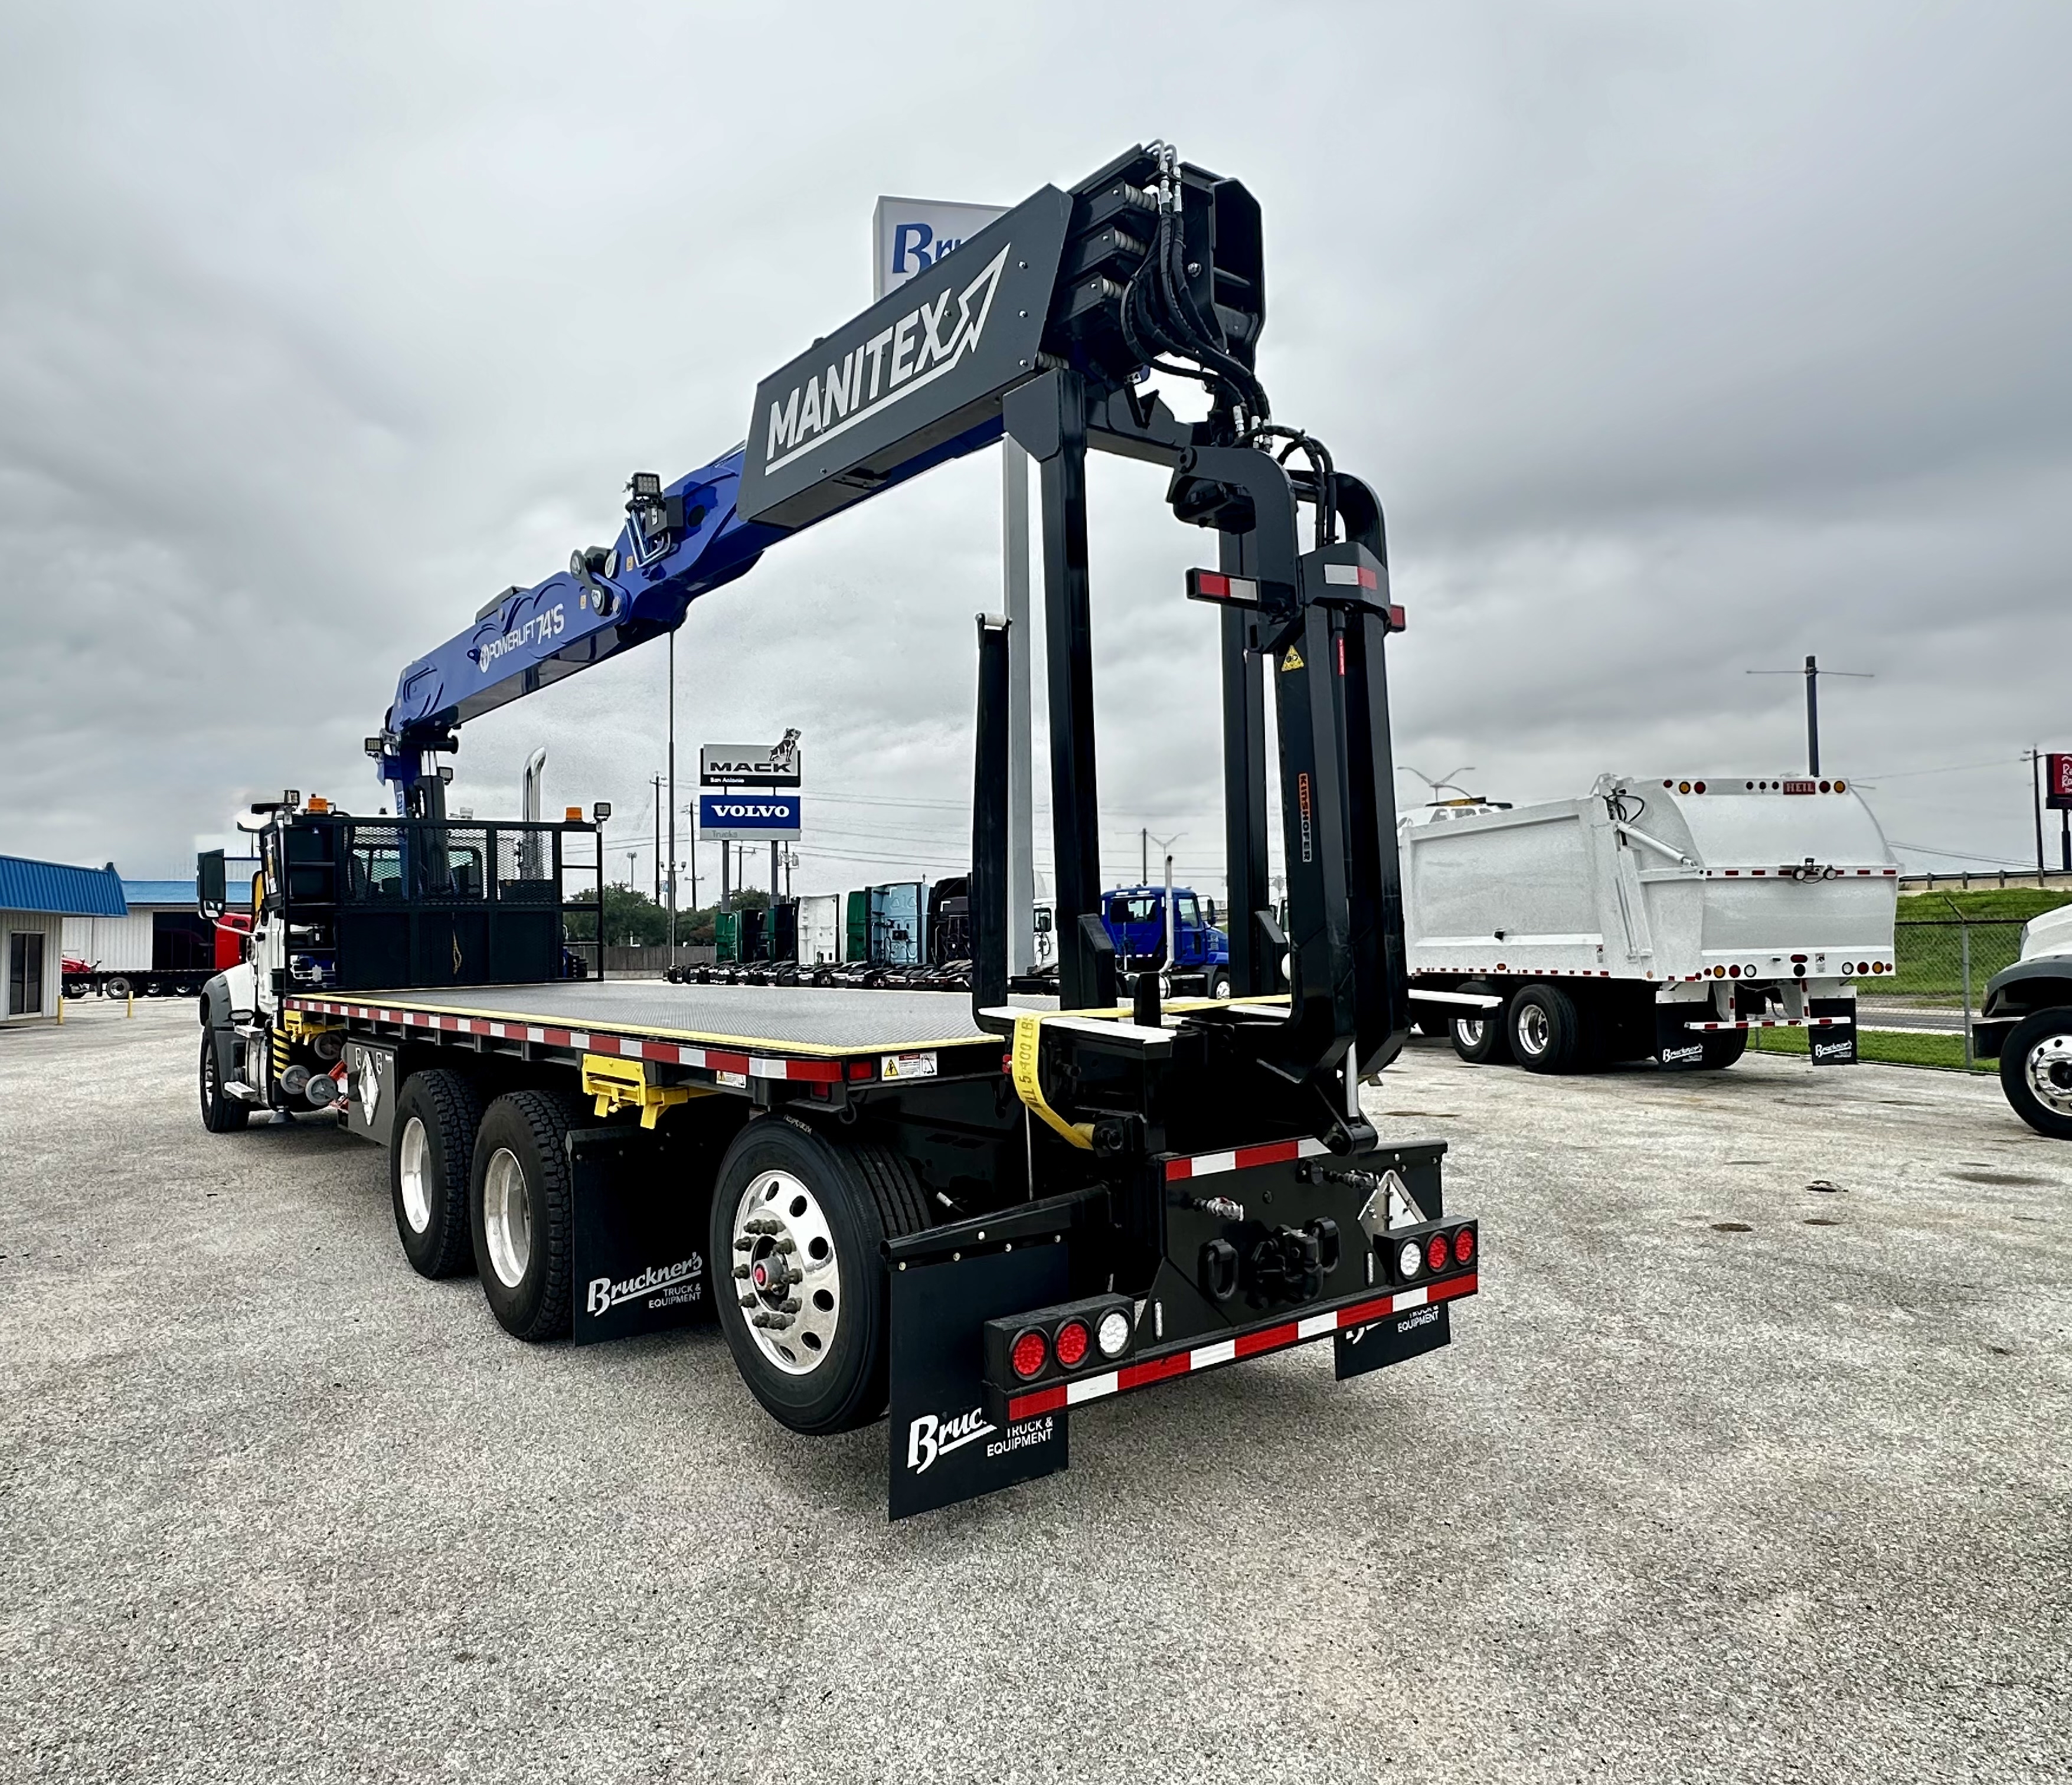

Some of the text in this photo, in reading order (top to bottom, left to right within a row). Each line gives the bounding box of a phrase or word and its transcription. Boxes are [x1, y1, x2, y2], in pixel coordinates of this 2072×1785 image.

[766, 287, 952, 461] MANITEX
[489, 603, 564, 662] POWERLIFT 74'S
[710, 762, 792, 773] MACK
[1786, 783, 1814, 792] HEIL
[711, 805, 790, 817] VOLVO
[712, 830, 738, 838] Trucks
[587, 1251, 702, 1317] Bruckner's
[663, 1283, 701, 1297] TRUCK &
[648, 1292, 701, 1309] EQUIPMENT
[1397, 1310, 1439, 1333] EQUIPMENT
[1045, 1416, 1053, 1428] &
[907, 1407, 987, 1475] Bruc
[987, 1428, 1053, 1457] EQUIPMENT
